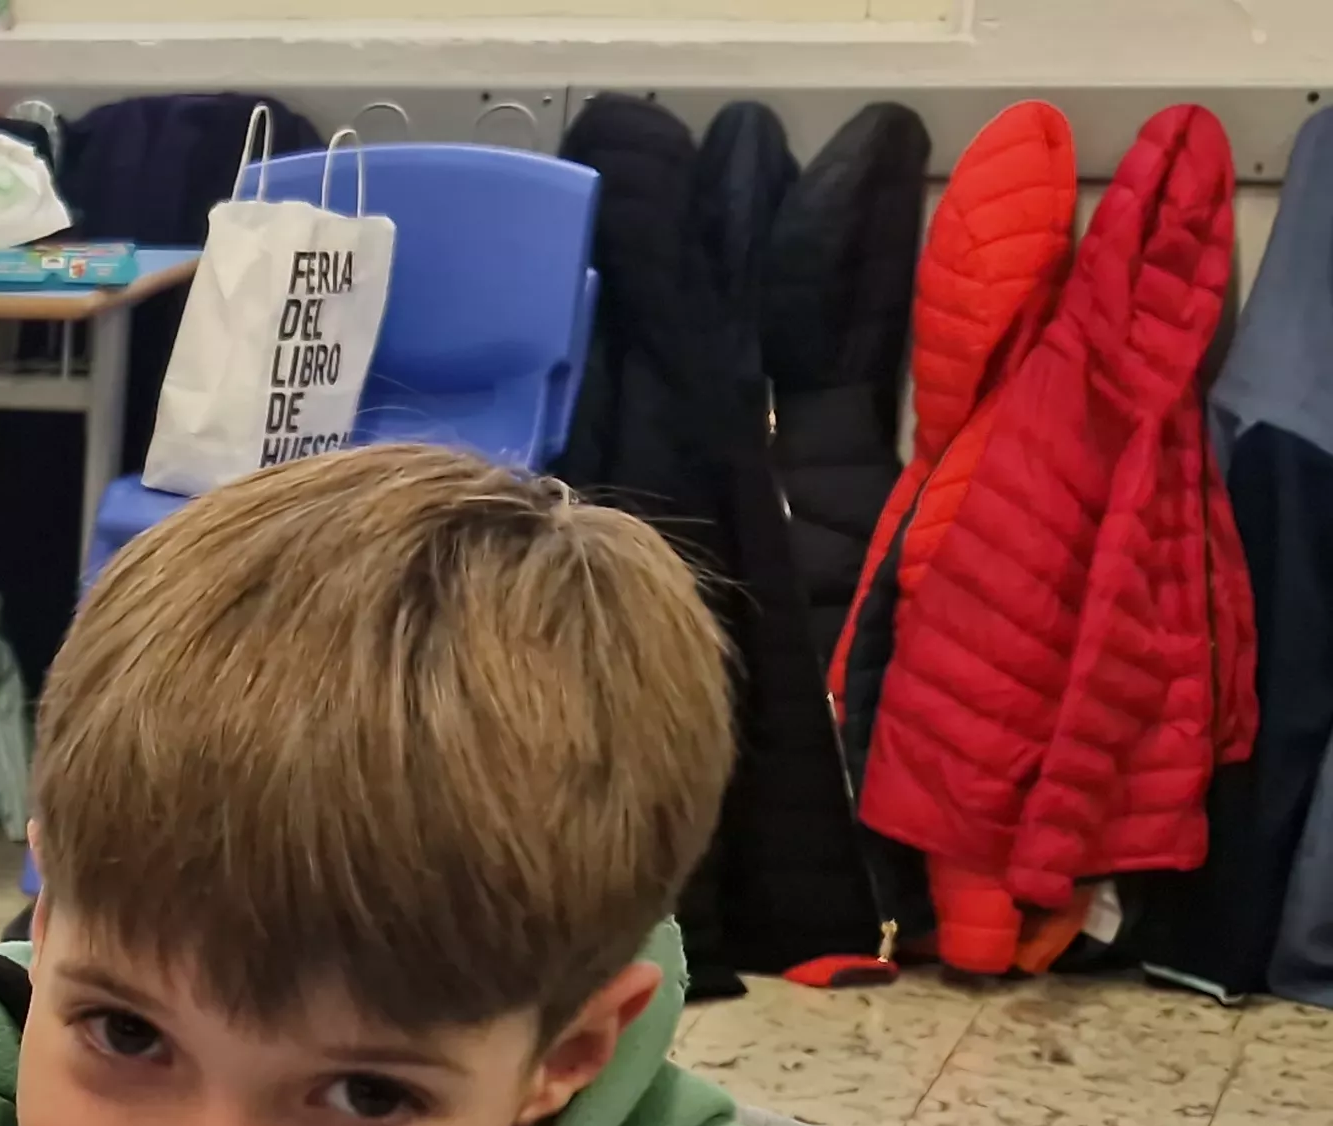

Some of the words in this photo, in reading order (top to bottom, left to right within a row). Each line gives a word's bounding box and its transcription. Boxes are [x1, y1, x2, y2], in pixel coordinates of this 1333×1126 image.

[289, 250, 353, 294] FERIA
[278, 298, 325, 341] DEL
[271, 343, 341, 387] LIBRO
[265, 392, 304, 434] DE
